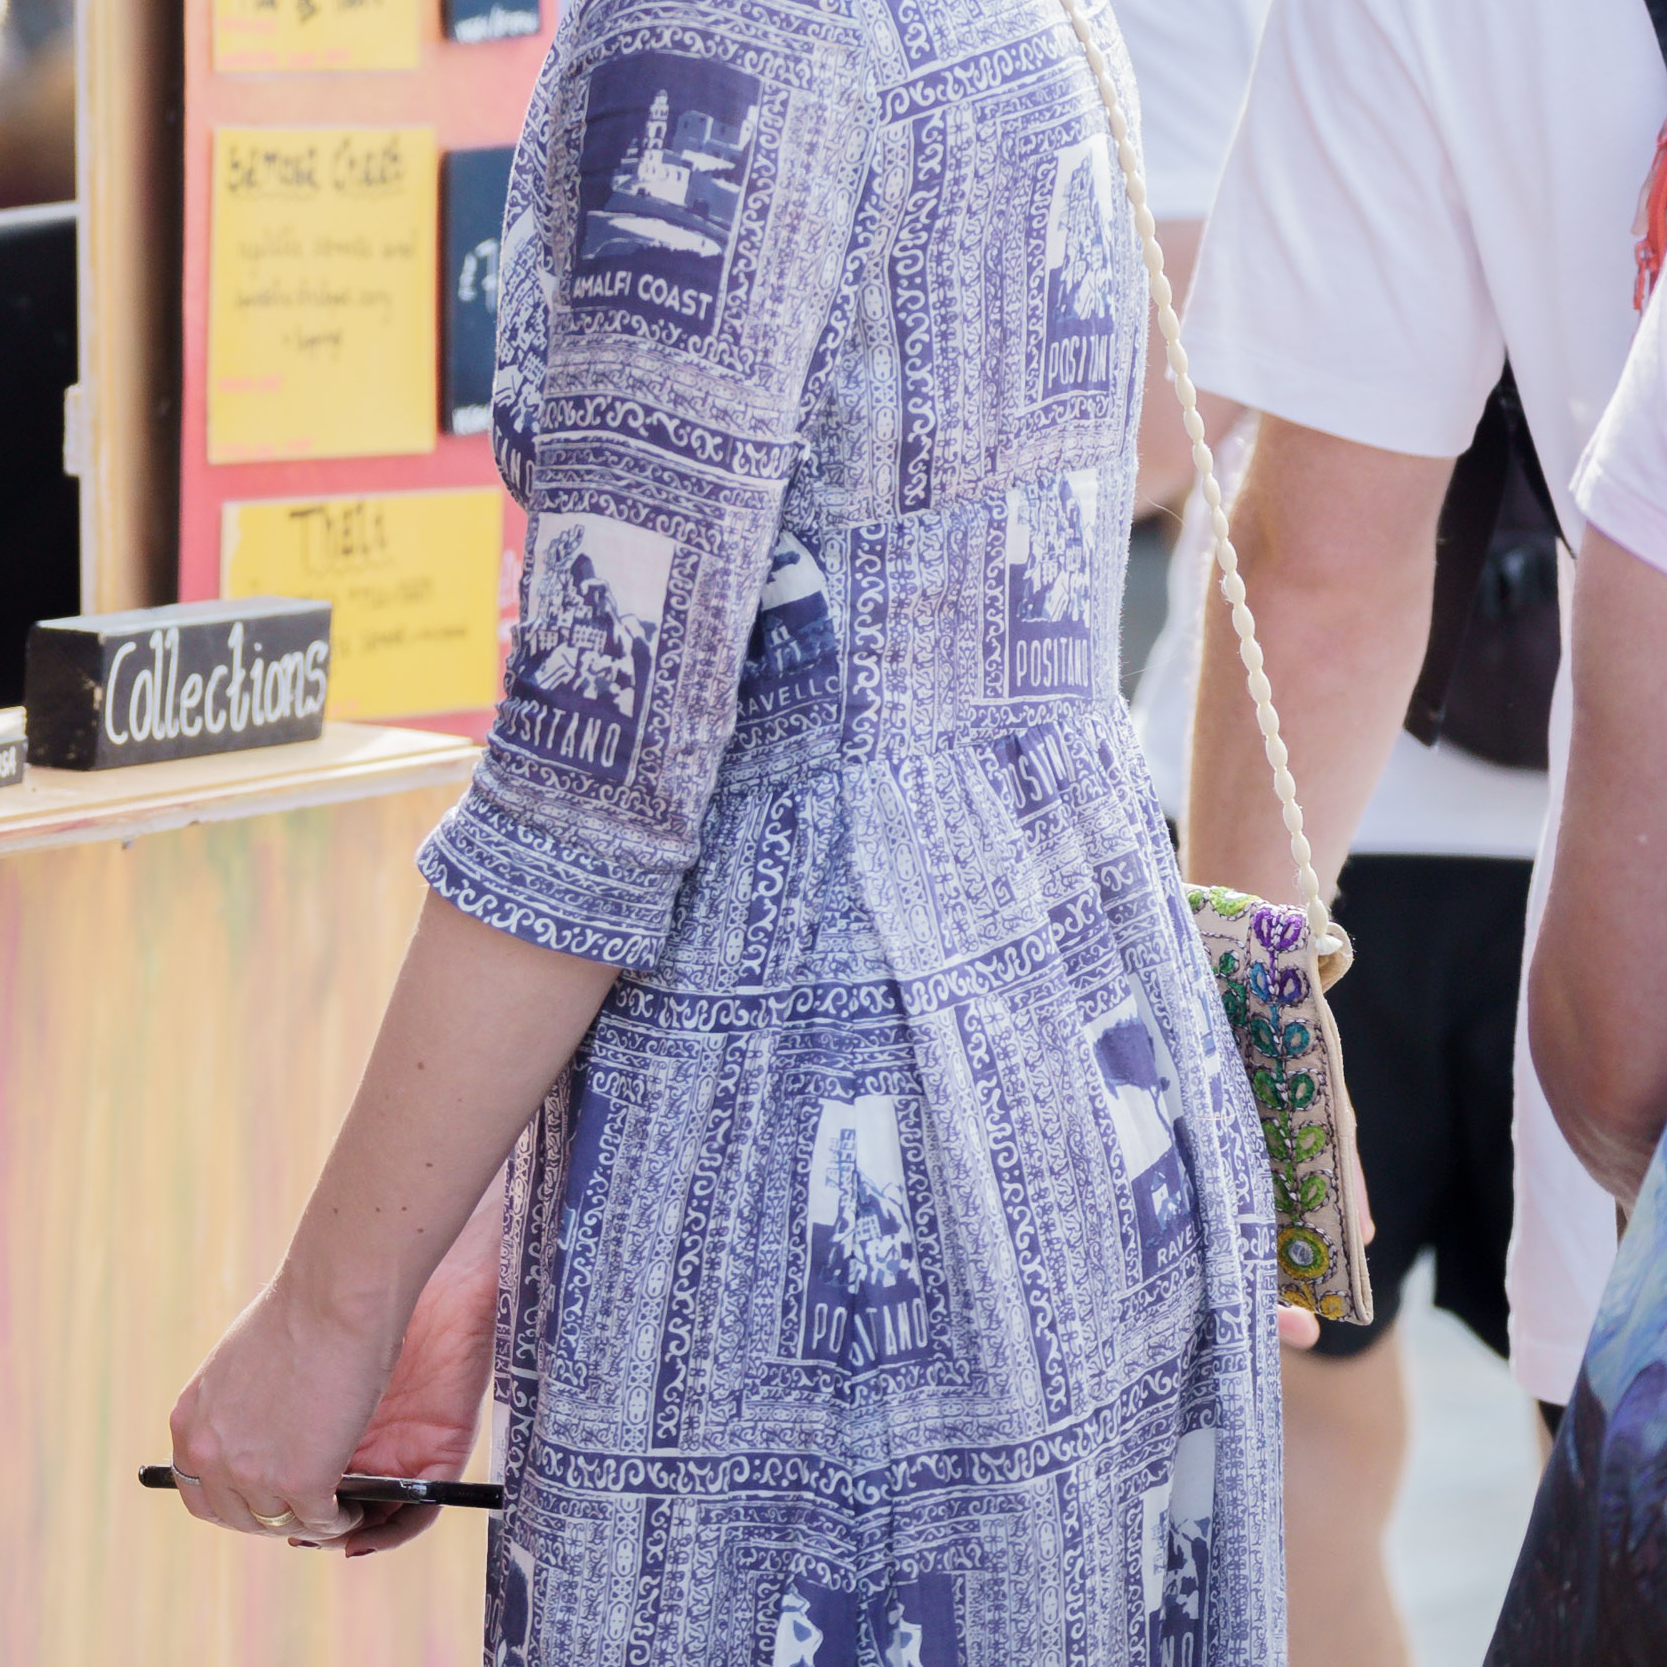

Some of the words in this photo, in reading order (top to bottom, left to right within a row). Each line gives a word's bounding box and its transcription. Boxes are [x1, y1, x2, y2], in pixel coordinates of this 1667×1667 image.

[573, 270, 633, 299] AMALFI
[637, 274, 713, 320] COAST
[104, 621, 329, 745] Collections
